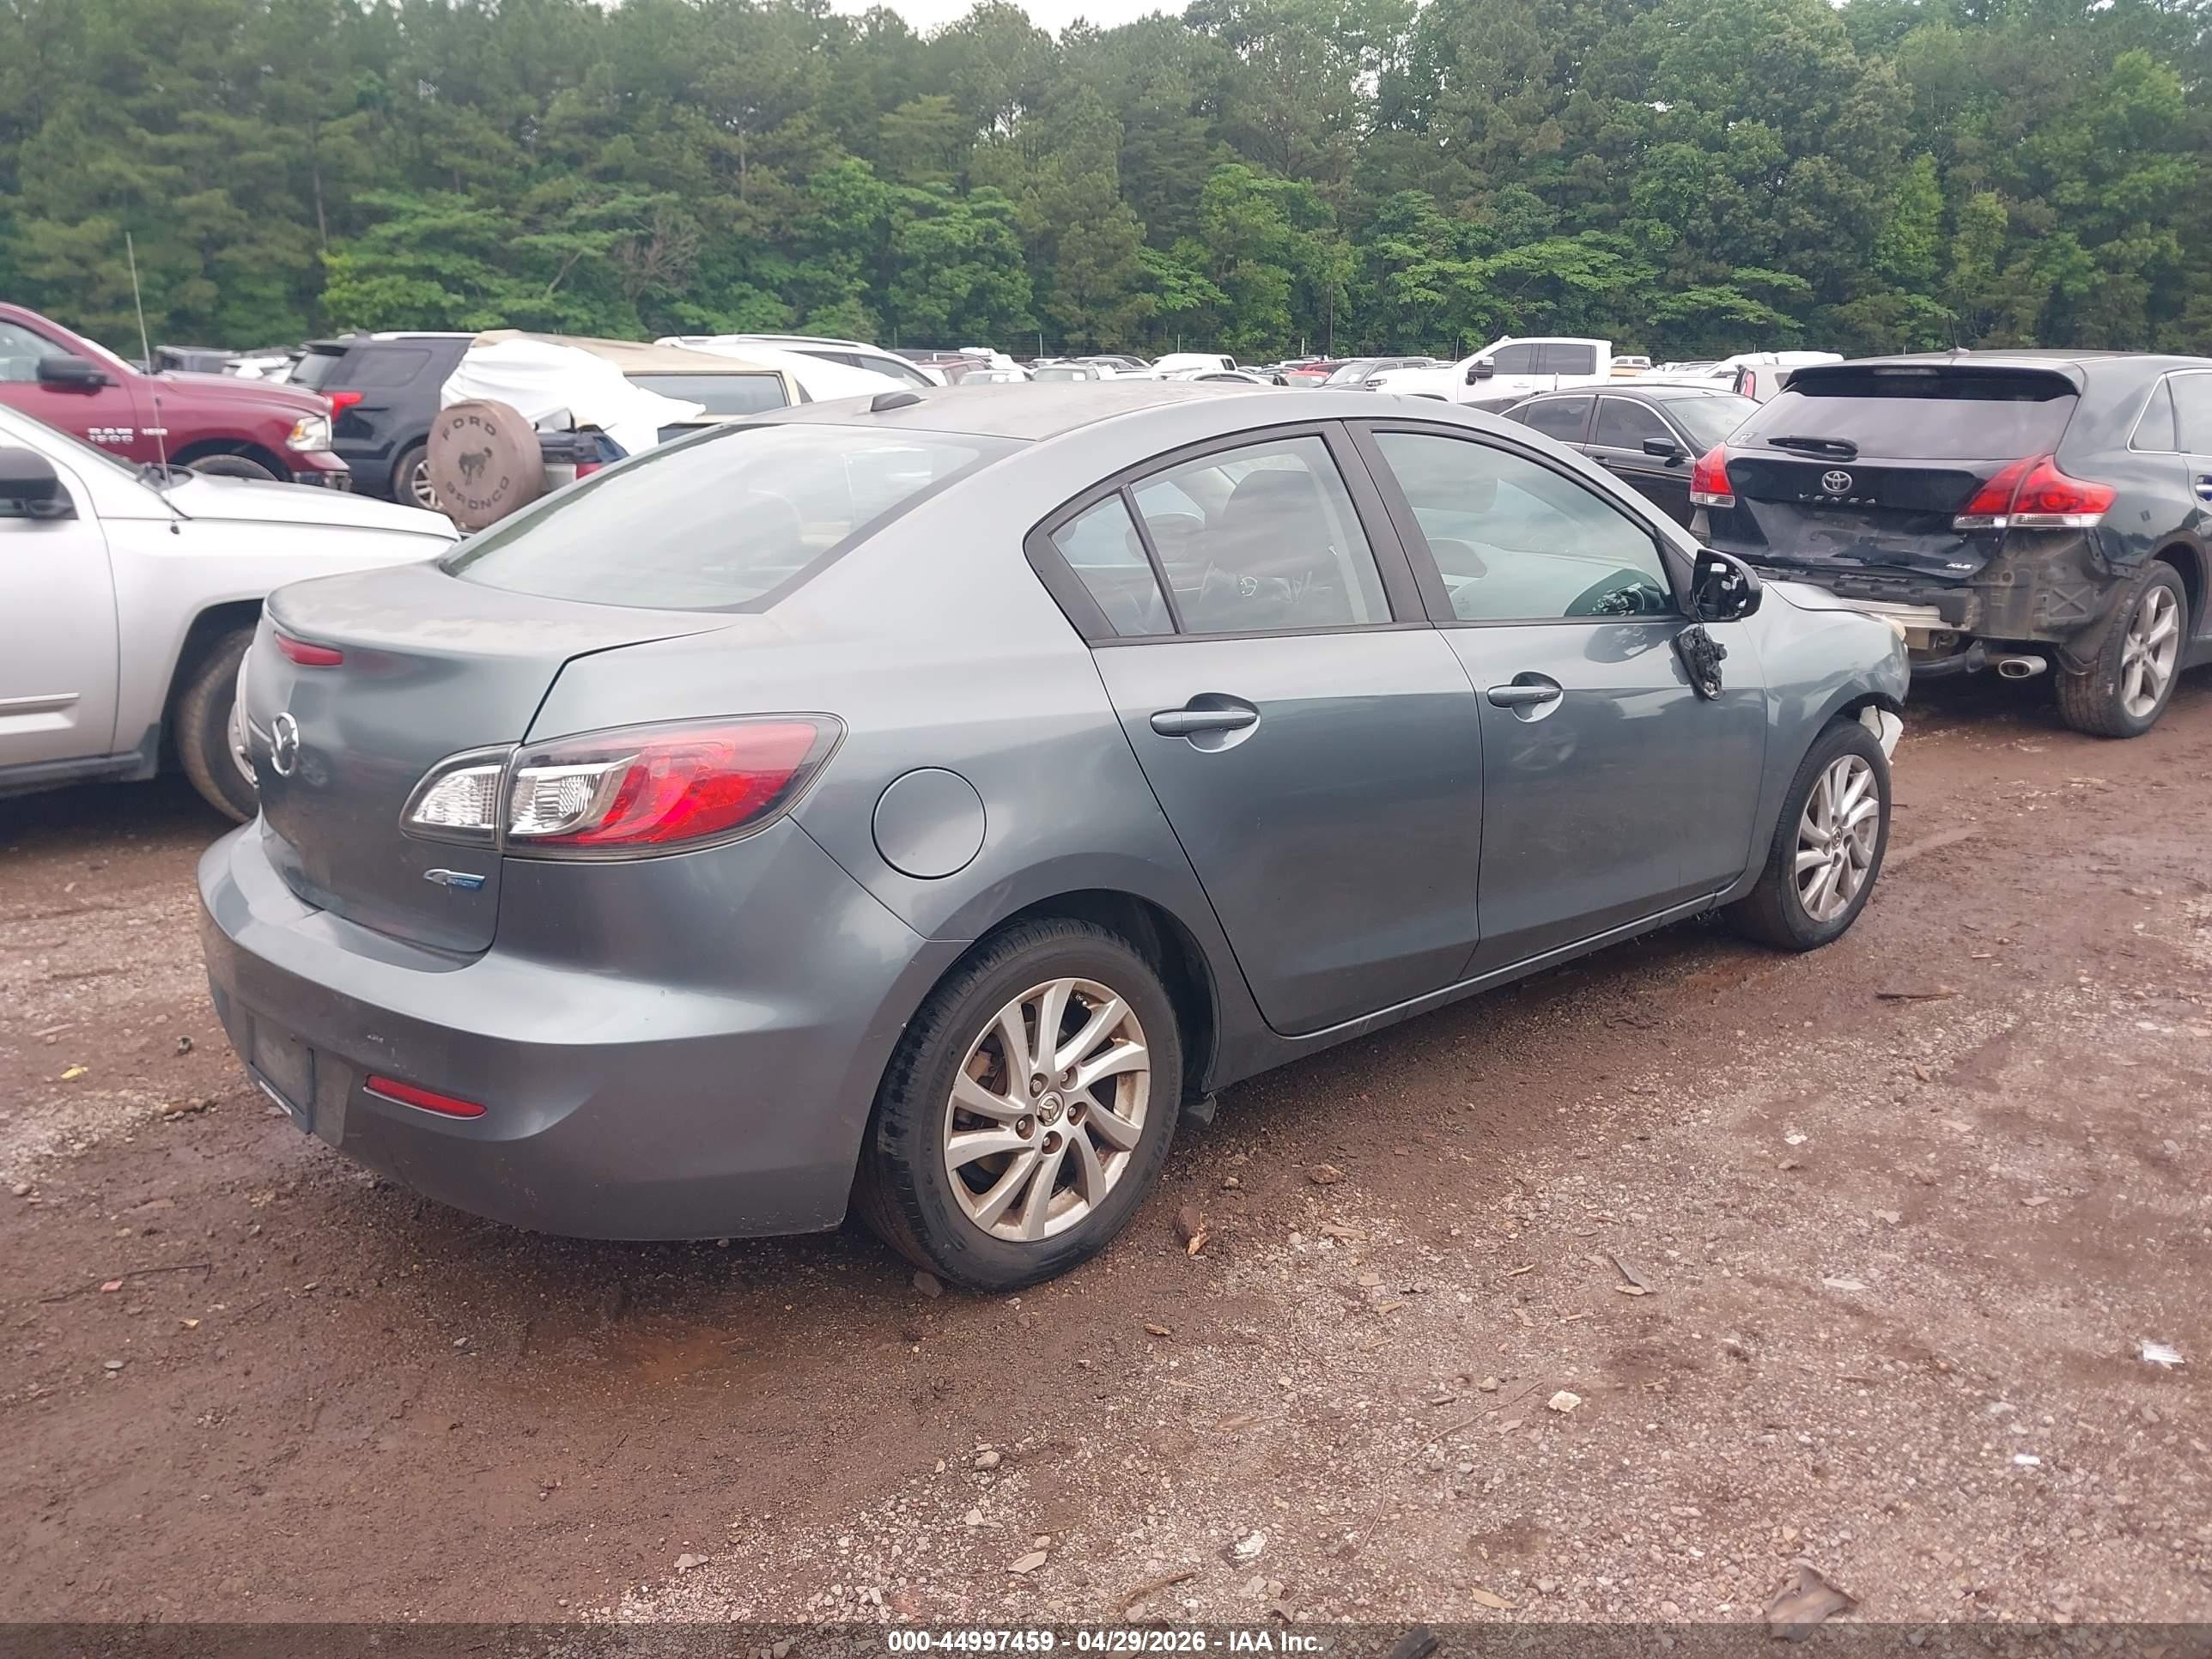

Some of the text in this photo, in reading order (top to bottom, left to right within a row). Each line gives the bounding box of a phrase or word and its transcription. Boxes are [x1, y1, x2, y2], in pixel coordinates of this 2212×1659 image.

[441, 416, 496, 441] FORD
[447, 476, 510, 510] BRONCO
[1799, 493, 1876, 504] VENZA
